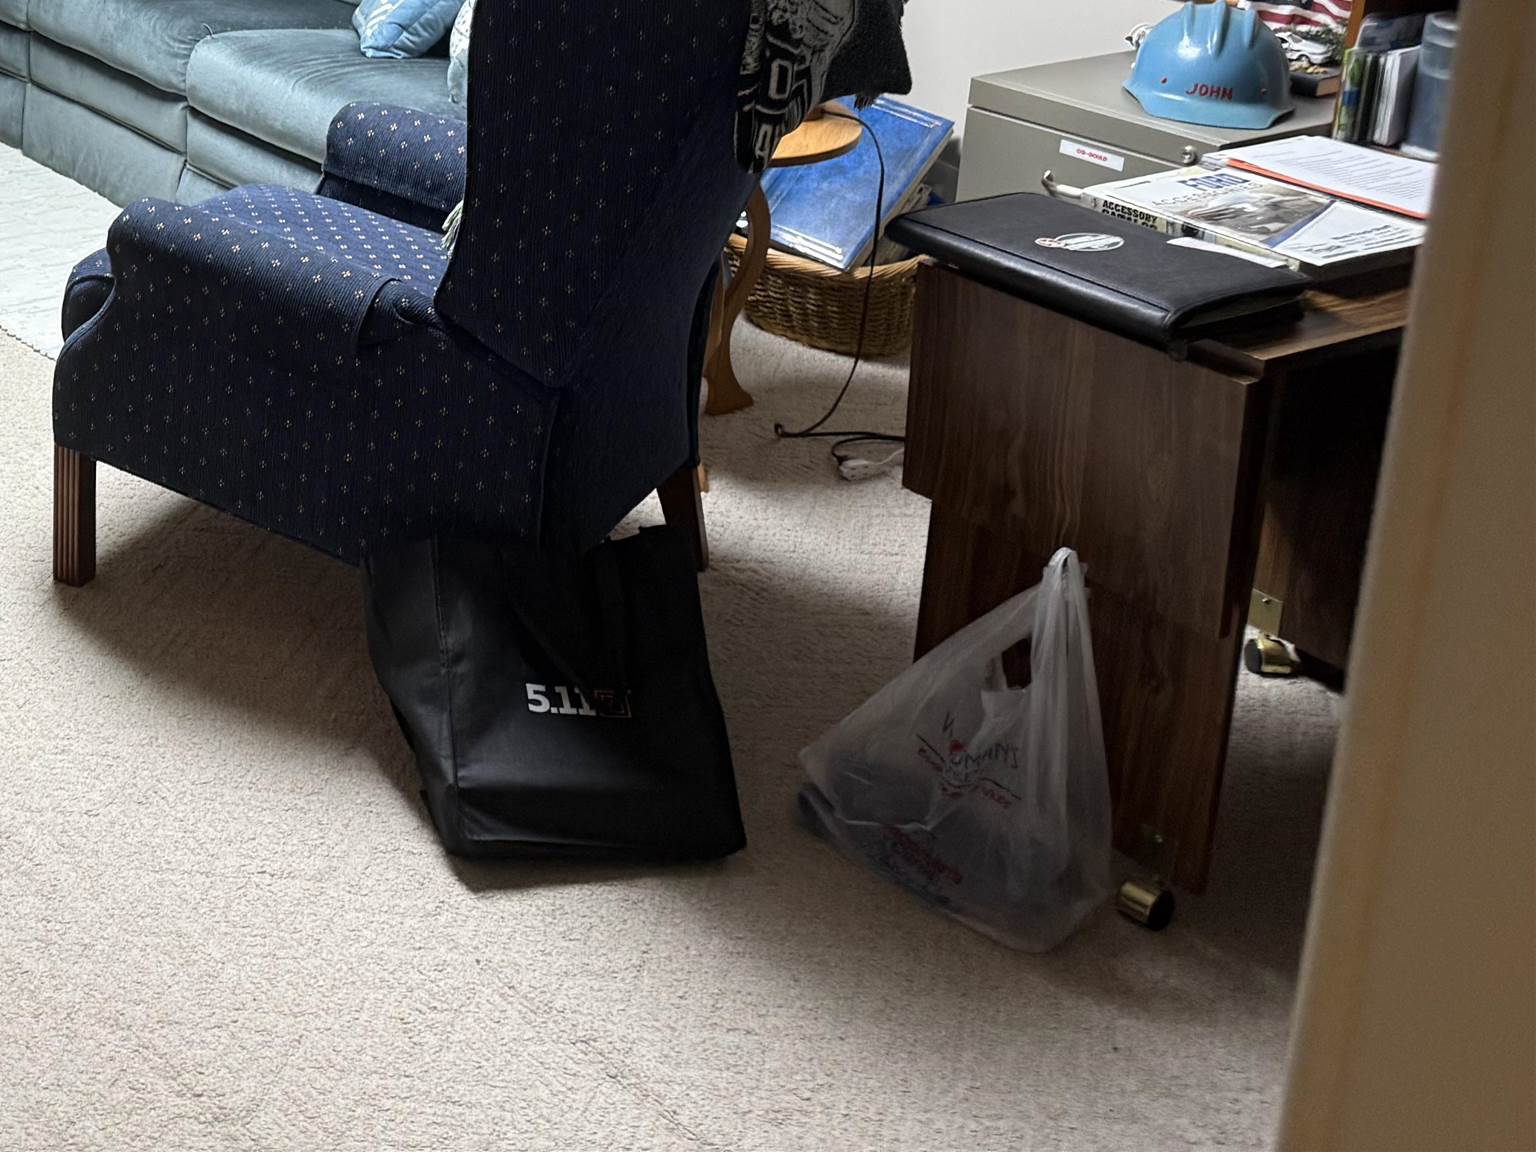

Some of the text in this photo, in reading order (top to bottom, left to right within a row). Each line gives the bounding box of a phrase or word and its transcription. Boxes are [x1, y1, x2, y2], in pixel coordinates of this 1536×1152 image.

[1185, 83, 1233, 101] JOHN
[1176, 173, 1251, 192] FORD
[1102, 200, 1158, 224] ACCESSORY
[525, 682, 597, 717] 5.11
